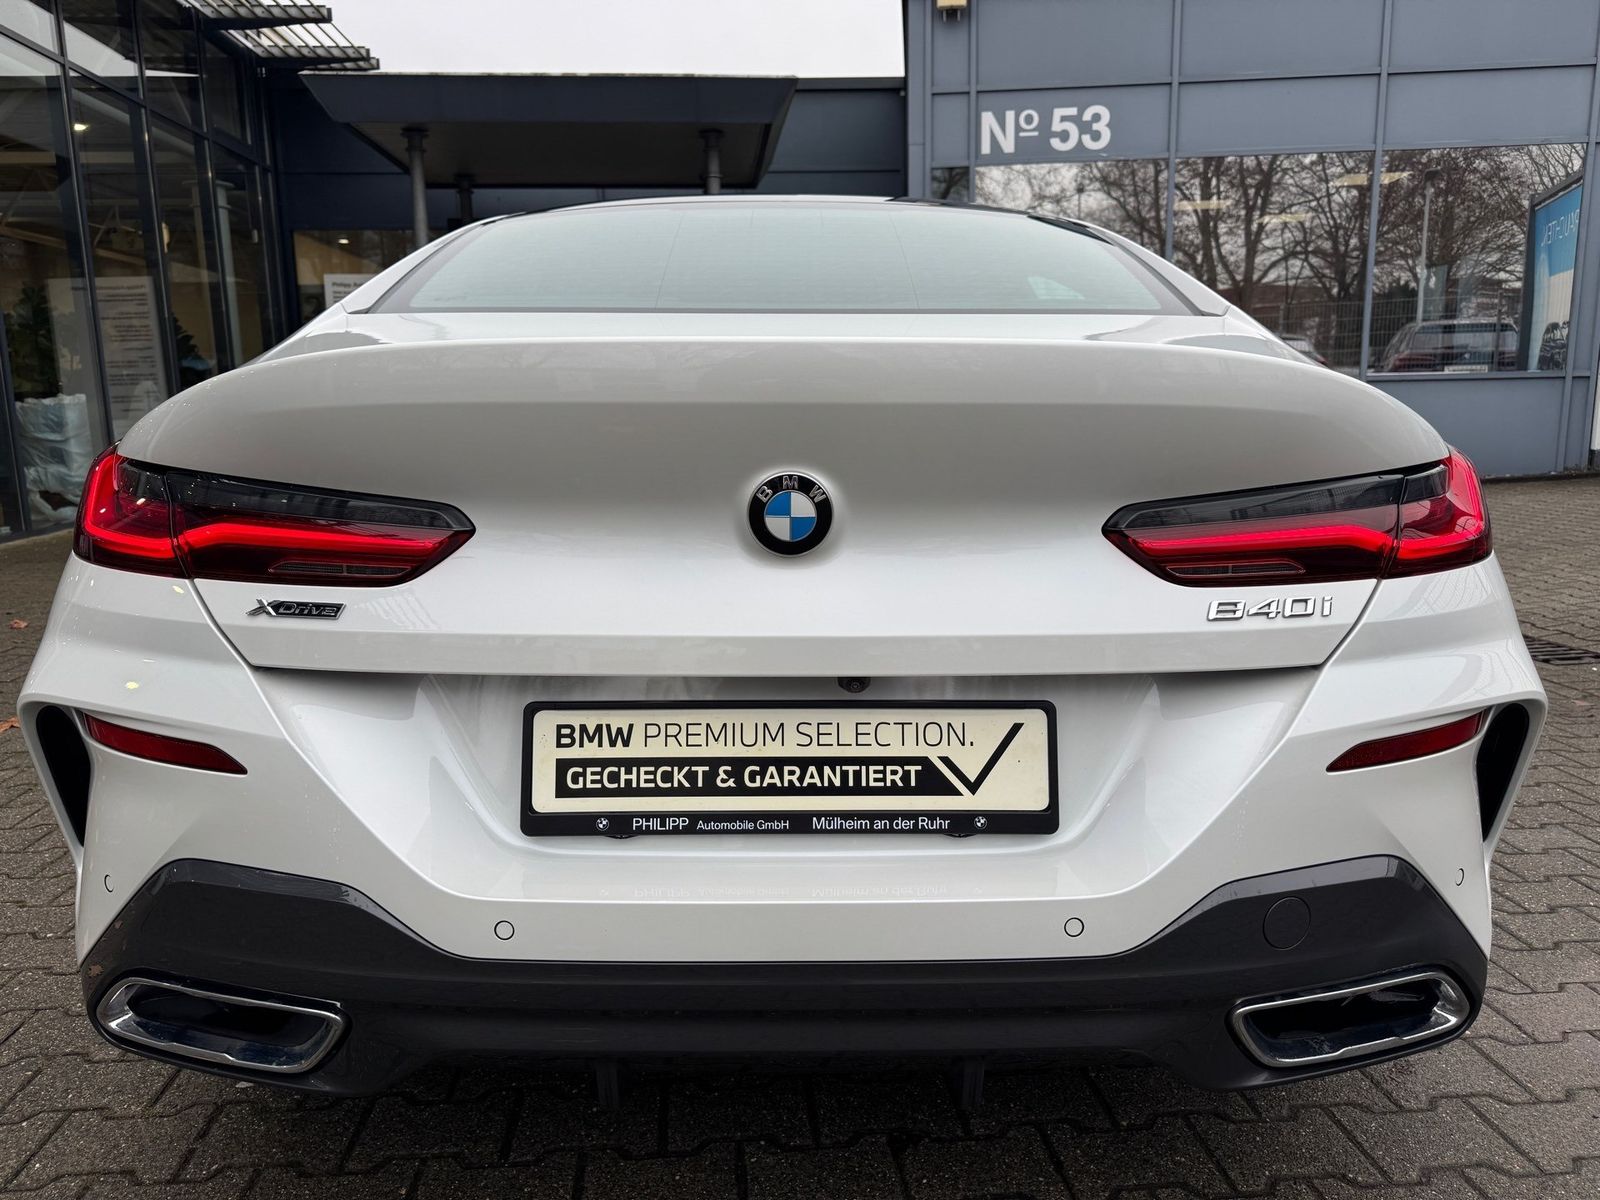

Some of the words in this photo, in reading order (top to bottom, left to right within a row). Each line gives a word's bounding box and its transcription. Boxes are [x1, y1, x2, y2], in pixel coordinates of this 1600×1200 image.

[1049, 104, 1111, 152] 53
[756, 475, 827, 503] BMW
[1206, 595, 1333, 621] 840i
[555, 722, 634, 749] BMW
[644, 721, 785, 748] PREMIUM
[795, 721, 974, 747] SELECTION.
[566, 765, 710, 789] GECHECKT
[715, 765, 737, 788] &
[743, 764, 922, 788] GARANTIERT
[632, 817, 689, 831] PHILIPP
[696, 820, 755, 830] Automobile
[756, 819, 790, 830] GmbH
[812, 816, 870, 831] Mülheim
[873, 819, 892, 830] an
[892, 816, 916, 831] der
[918, 816, 951, 830] Ruhr
